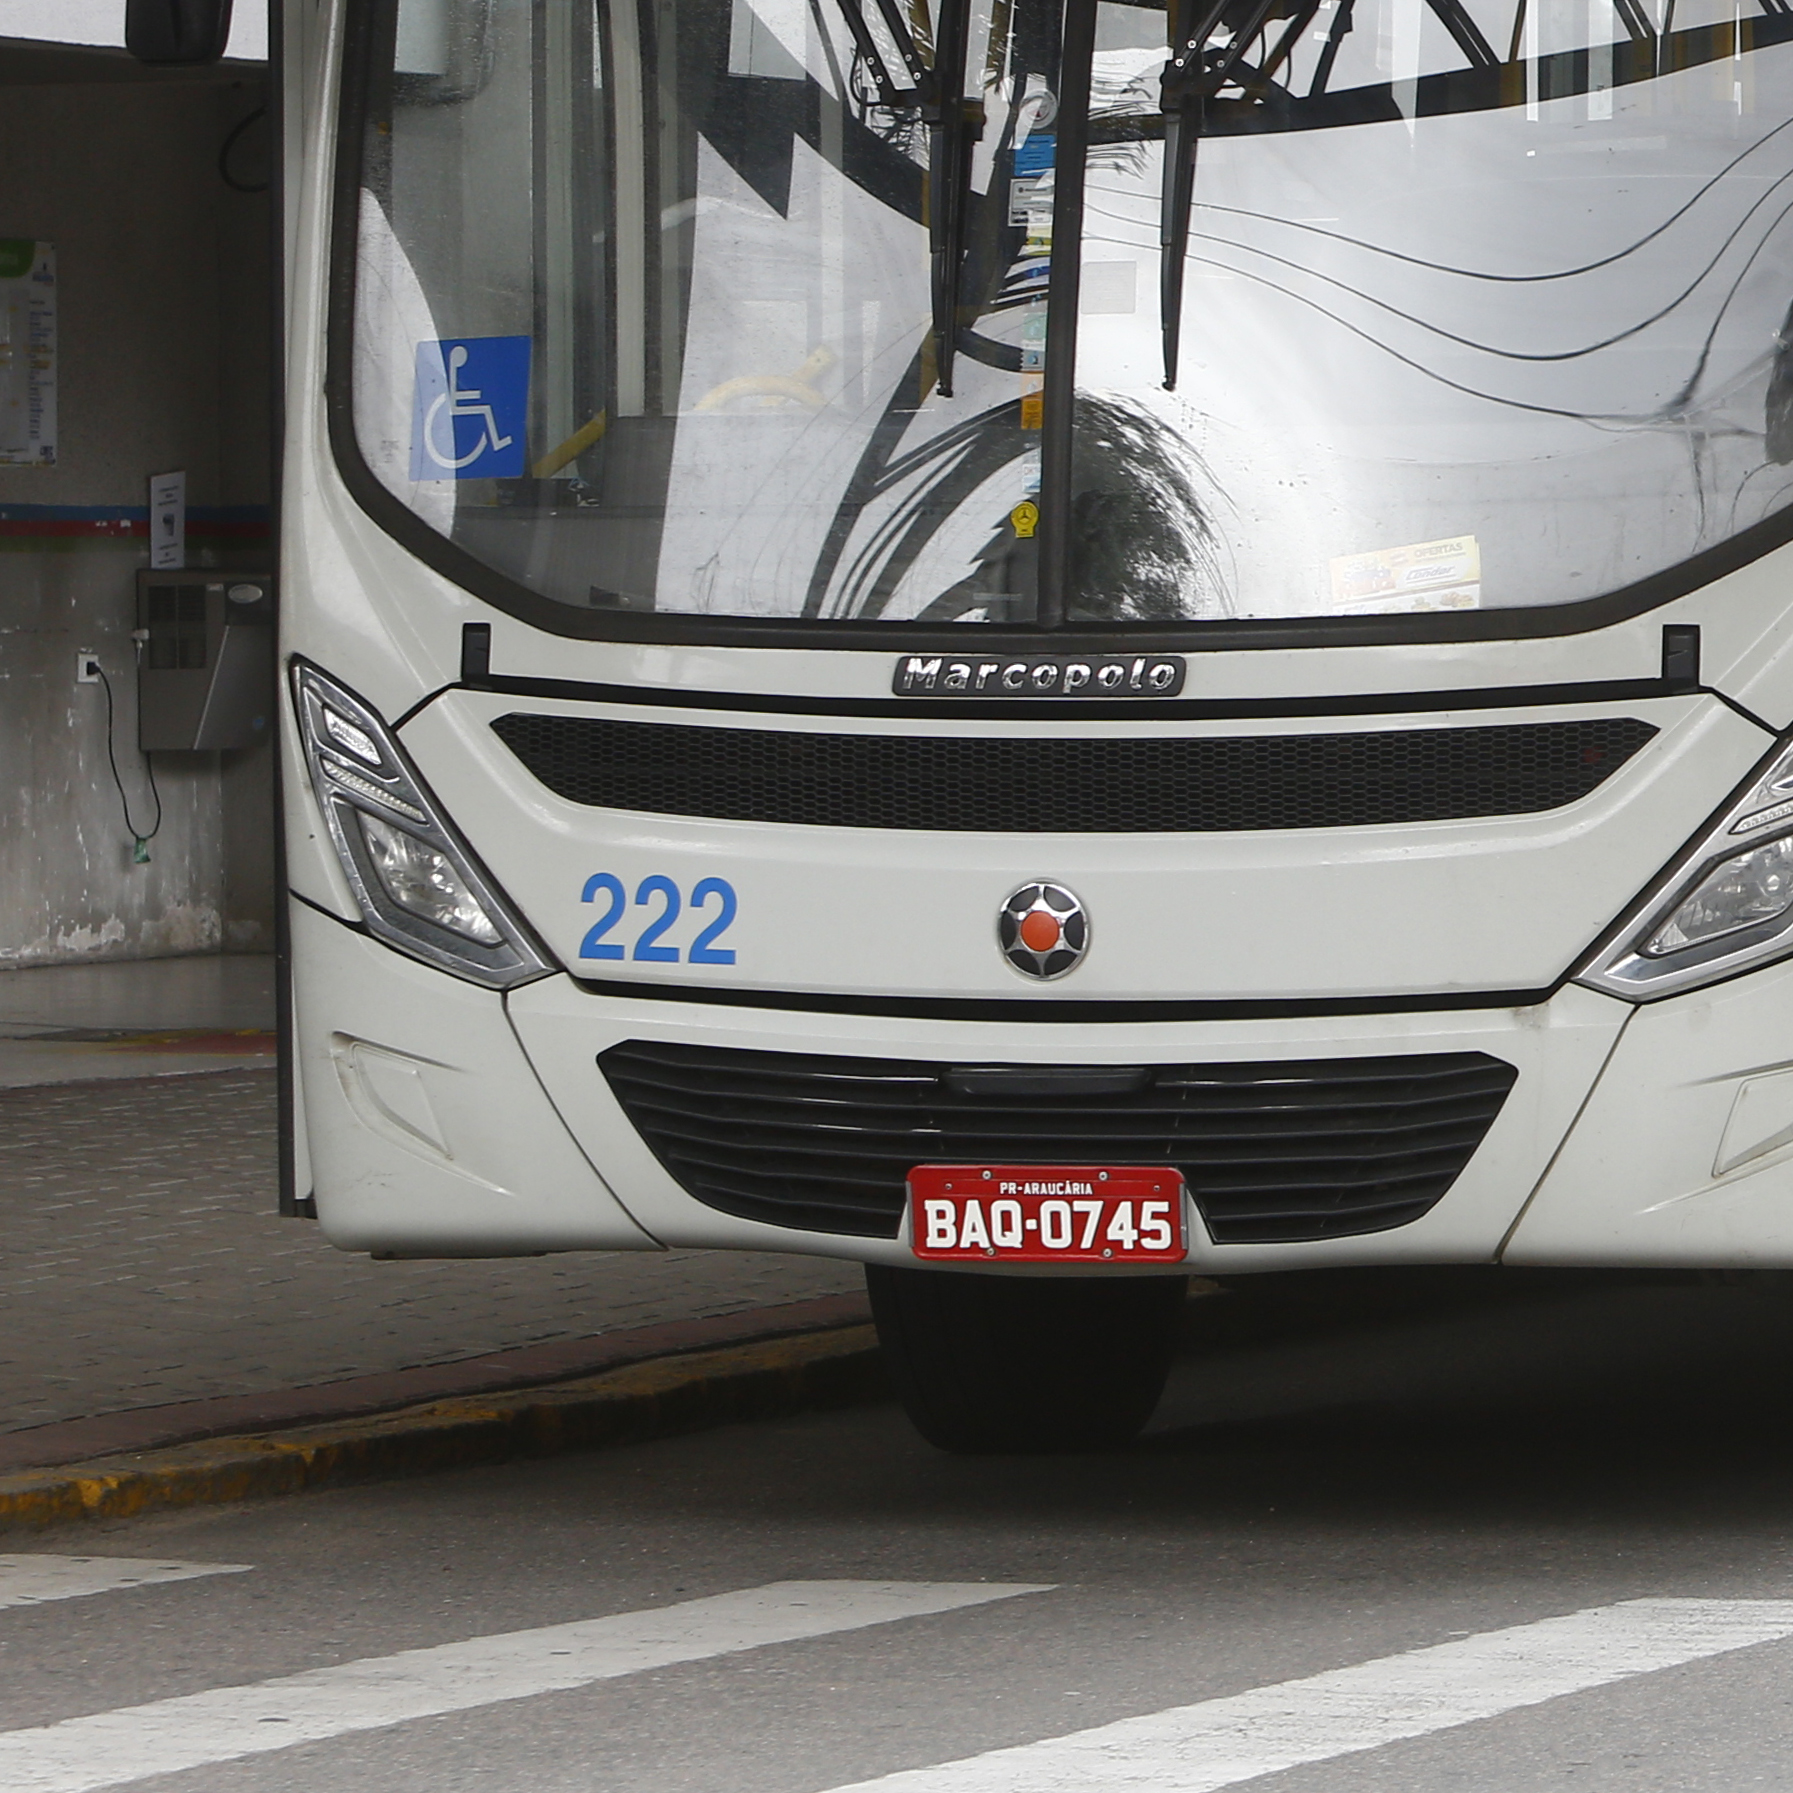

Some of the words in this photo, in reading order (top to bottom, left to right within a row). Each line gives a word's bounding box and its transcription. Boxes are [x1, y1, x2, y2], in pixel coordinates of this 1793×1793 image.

[902, 657, 1178, 696] Marcopolo
[578, 872, 738, 966] 222
[999, 1178, 1093, 1197] PR-ARAUCÁRIA
[924, 1199, 1172, 1251] BAQ-0745
